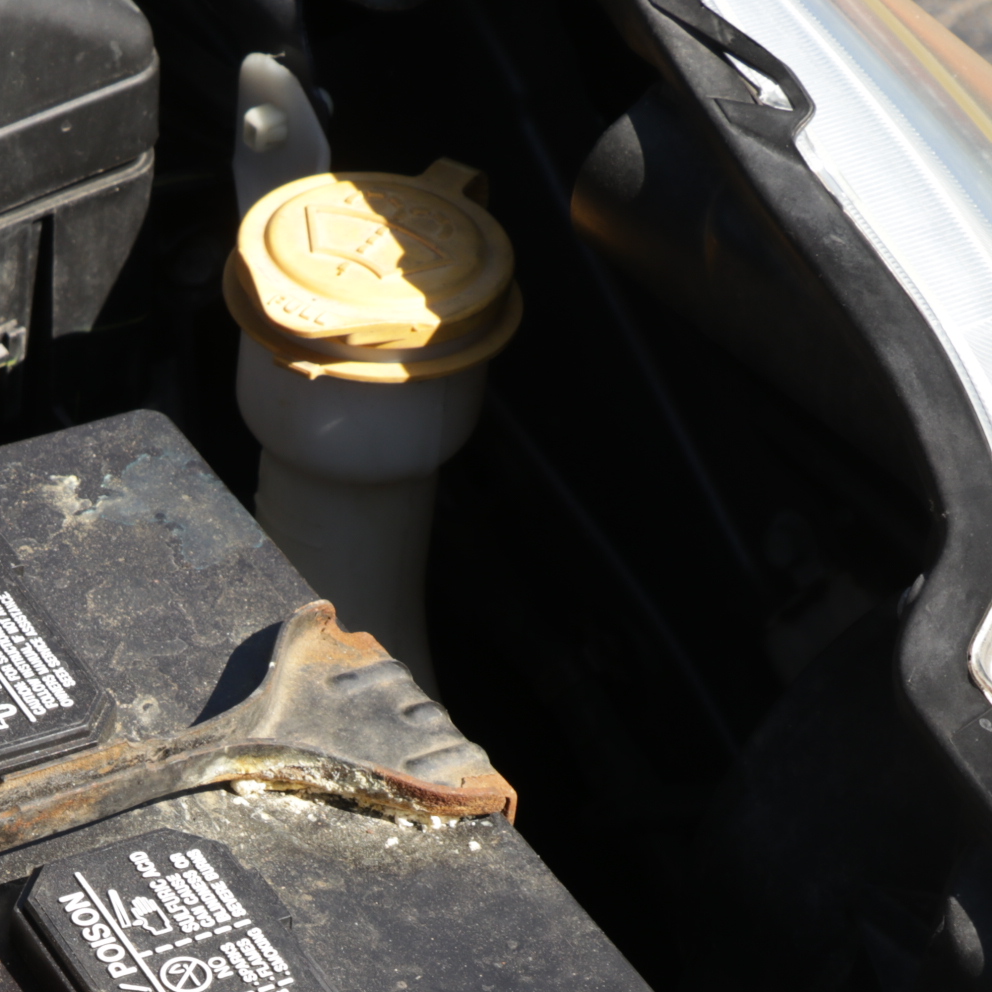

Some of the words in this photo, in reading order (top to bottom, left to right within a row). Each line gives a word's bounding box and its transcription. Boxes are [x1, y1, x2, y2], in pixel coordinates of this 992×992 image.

[10, 634, 27, 643] IF
[28, 636, 61, 668] SERVICE
[0, 663, 21, 681] FOR
[51, 666, 76, 688] SEEK
[26, 677, 59, 709] FOLLOW
[129, 850, 162, 878] ACID
[169, 851, 191, 869] OR
[185, 848, 220, 882] BURNS
[149, 878, 202, 933] SULFURIC
[165, 872, 200, 906] CAUSE
[179, 869, 232, 923] BLINDNESS
[208, 879, 249, 918] SEVERE
[188, 904, 216, 928] CAN
[58, 890, 138, 979] POISON
[245, 926, 290, 973] SMOKING
[207, 955, 235, 979] NO
[219, 941, 259, 983] SPARKS
[235, 937, 275, 978] FLAMES
